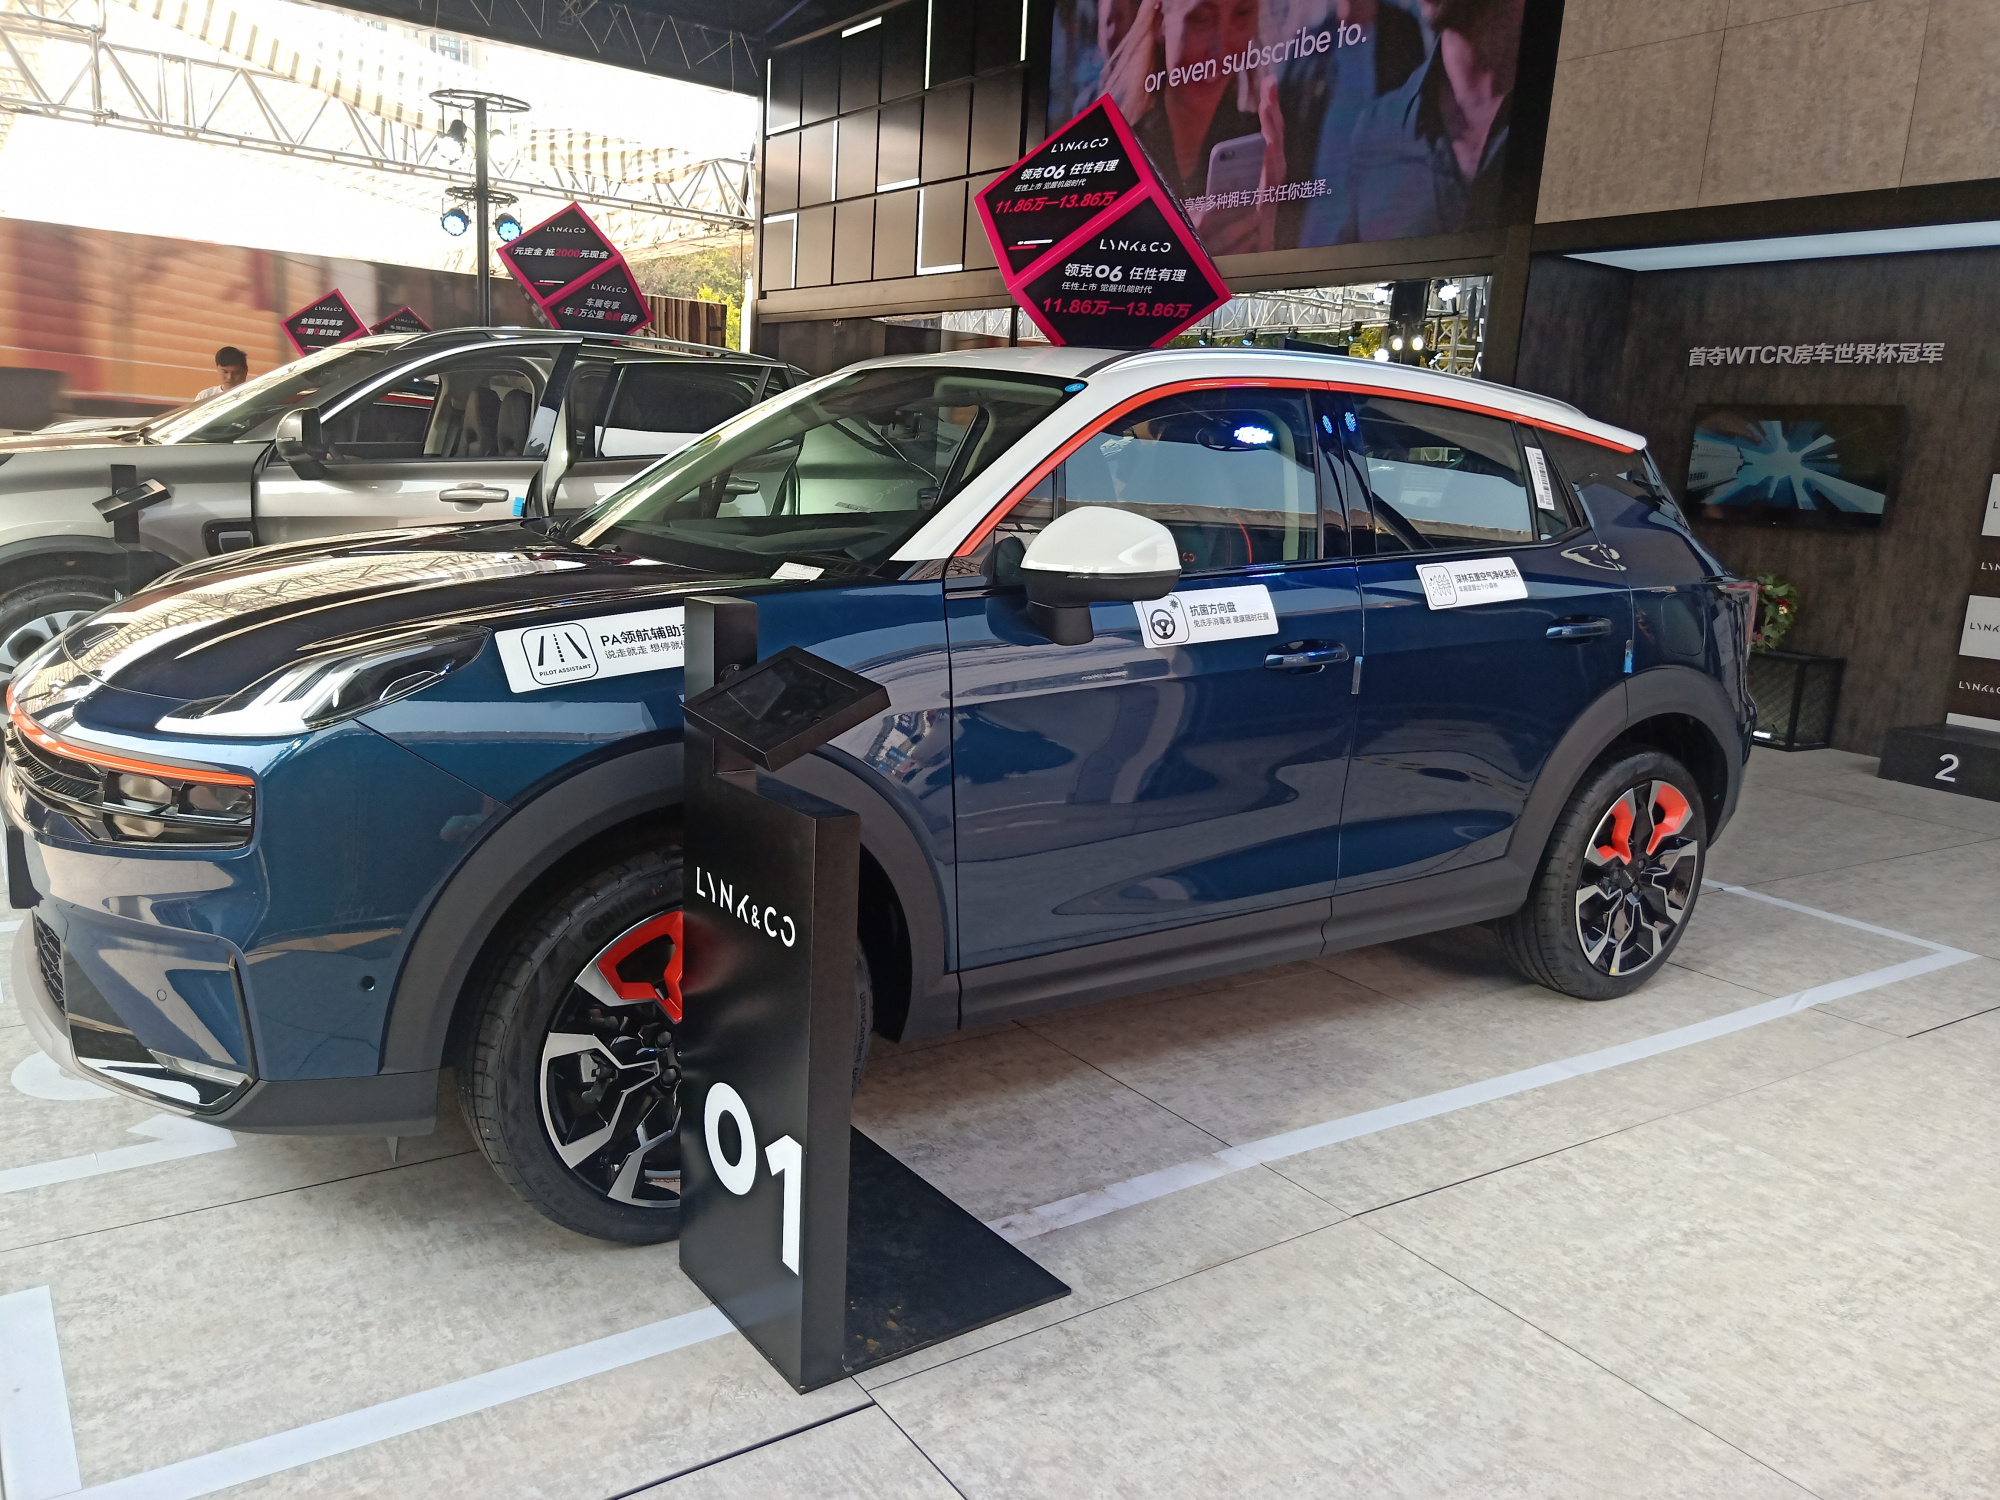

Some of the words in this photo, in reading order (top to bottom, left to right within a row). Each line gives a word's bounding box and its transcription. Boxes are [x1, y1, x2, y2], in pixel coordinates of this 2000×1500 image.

[1144, 70, 1166, 92] or
[1168, 58, 1217, 87] even
[1221, 27, 1331, 75] subscribe
[1337, 19, 1367, 48] to.
[1020, 164, 1065, 180] 领克06
[1069, 159, 1119, 176] 任性有理
[1014, 183, 1042, 193] 任性上市
[1043, 178, 1087, 190] 觉醒机能时代
[1179, 179, 1332, 212] 享等多种拥车方式任你选择。
[1064, 263, 1123, 282] 领克06
[1129, 267, 1187, 282] 任性有理
[1061, 281, 1097, 292] 任性上市
[1100, 283, 1153, 294] 觉醒机能时代
[1688, 342, 1945, 366] 首夺WTCR房车世界杯冠军
[1189, 602, 1237, 617] 抗菌方向盘
[1969, 621, 2000, 633] LYNK
[604, 645, 648, 659] 说走就走
[539, 669, 558, 677] PILOT
[558, 664, 592, 674] ASSISTANT
[1934, 753, 1960, 783] 2
[704, 1082, 802, 1276] 01
